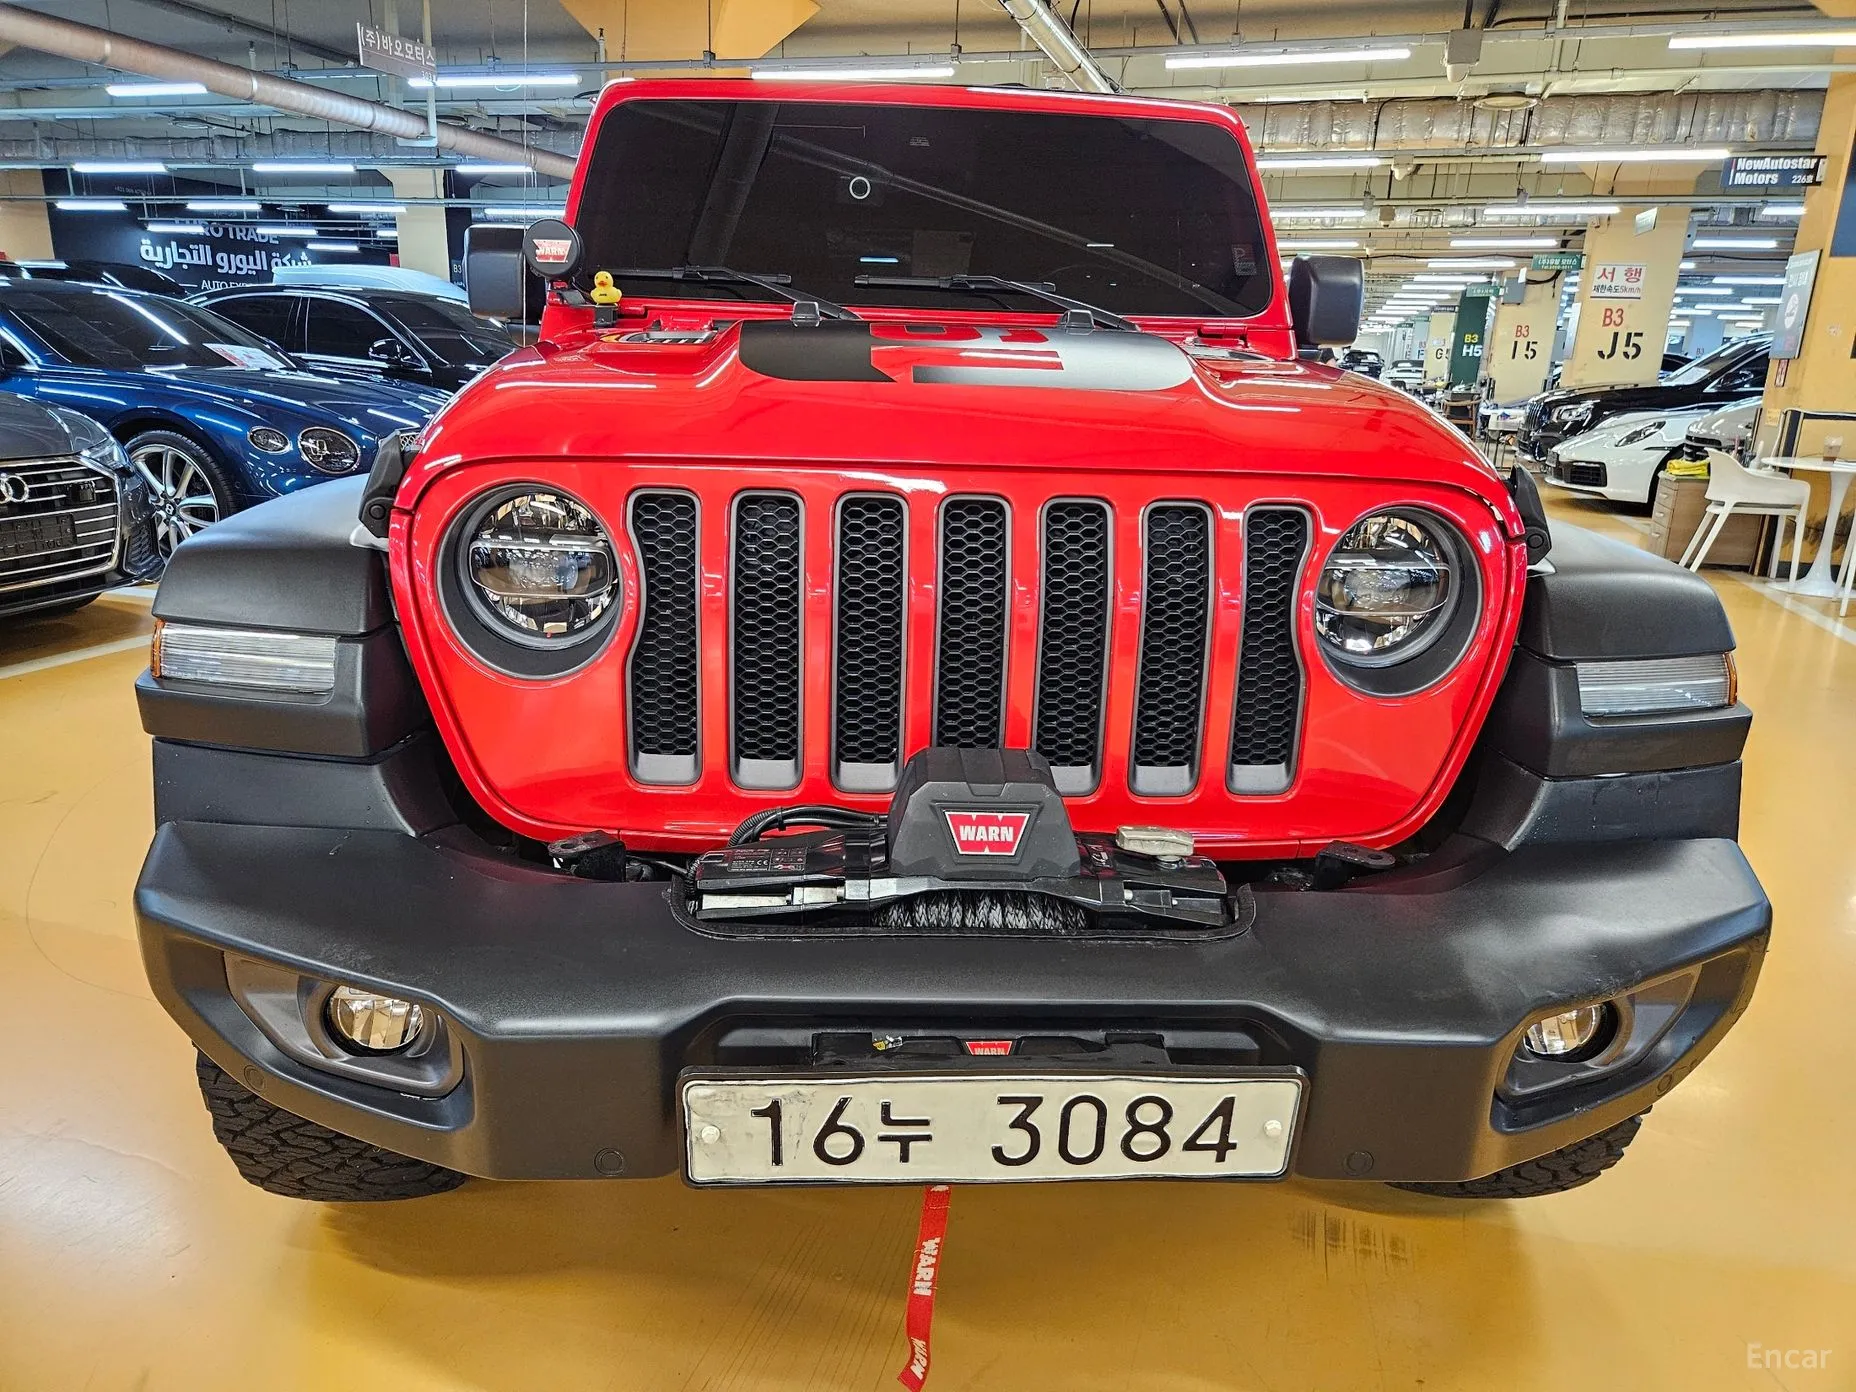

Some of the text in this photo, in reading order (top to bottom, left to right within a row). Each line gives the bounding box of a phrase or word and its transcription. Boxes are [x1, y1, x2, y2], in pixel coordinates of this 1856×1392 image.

[360, 26, 435, 67] (주)바오모터스
[1736, 157, 1817, 171] NewAutostar
[1734, 172, 1779, 185] Motors
[215, 250, 268, 275] اليورو
[1602, 308, 1624, 327] B3
[1464, 334, 1479, 343] B3
[1515, 325, 1530, 337] B3
[1462, 345, 1482, 357] H5
[1597, 331, 1643, 360] J5
[960, 825, 1014, 842] WARN
[974, 1047, 1005, 1055] WARN
[750, 1095, 1237, 1167] 16누 3084
[913, 1236, 941, 1296] WARN
